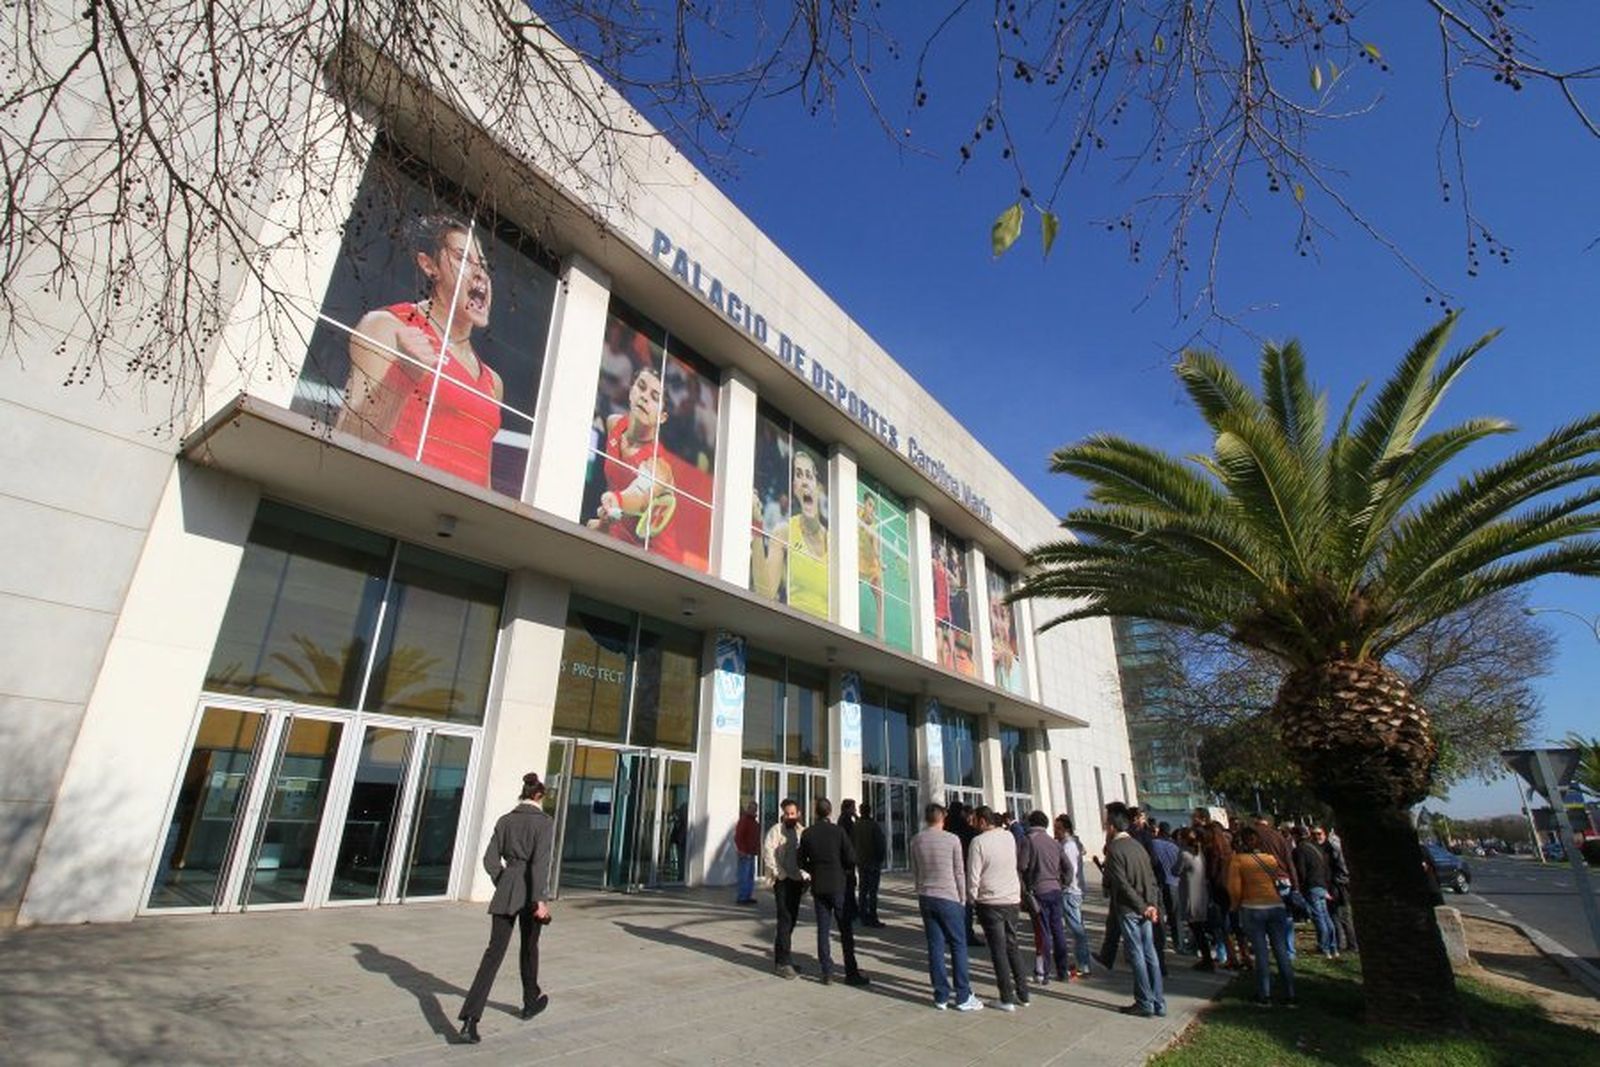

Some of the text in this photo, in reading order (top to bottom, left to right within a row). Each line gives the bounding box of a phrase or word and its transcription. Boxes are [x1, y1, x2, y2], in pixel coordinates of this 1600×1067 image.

[652, 228, 768, 343] PALACIO
[779, 332, 806, 375] DE
[811, 358, 899, 450] DEPORTES
[908, 436, 960, 498] Carolina
